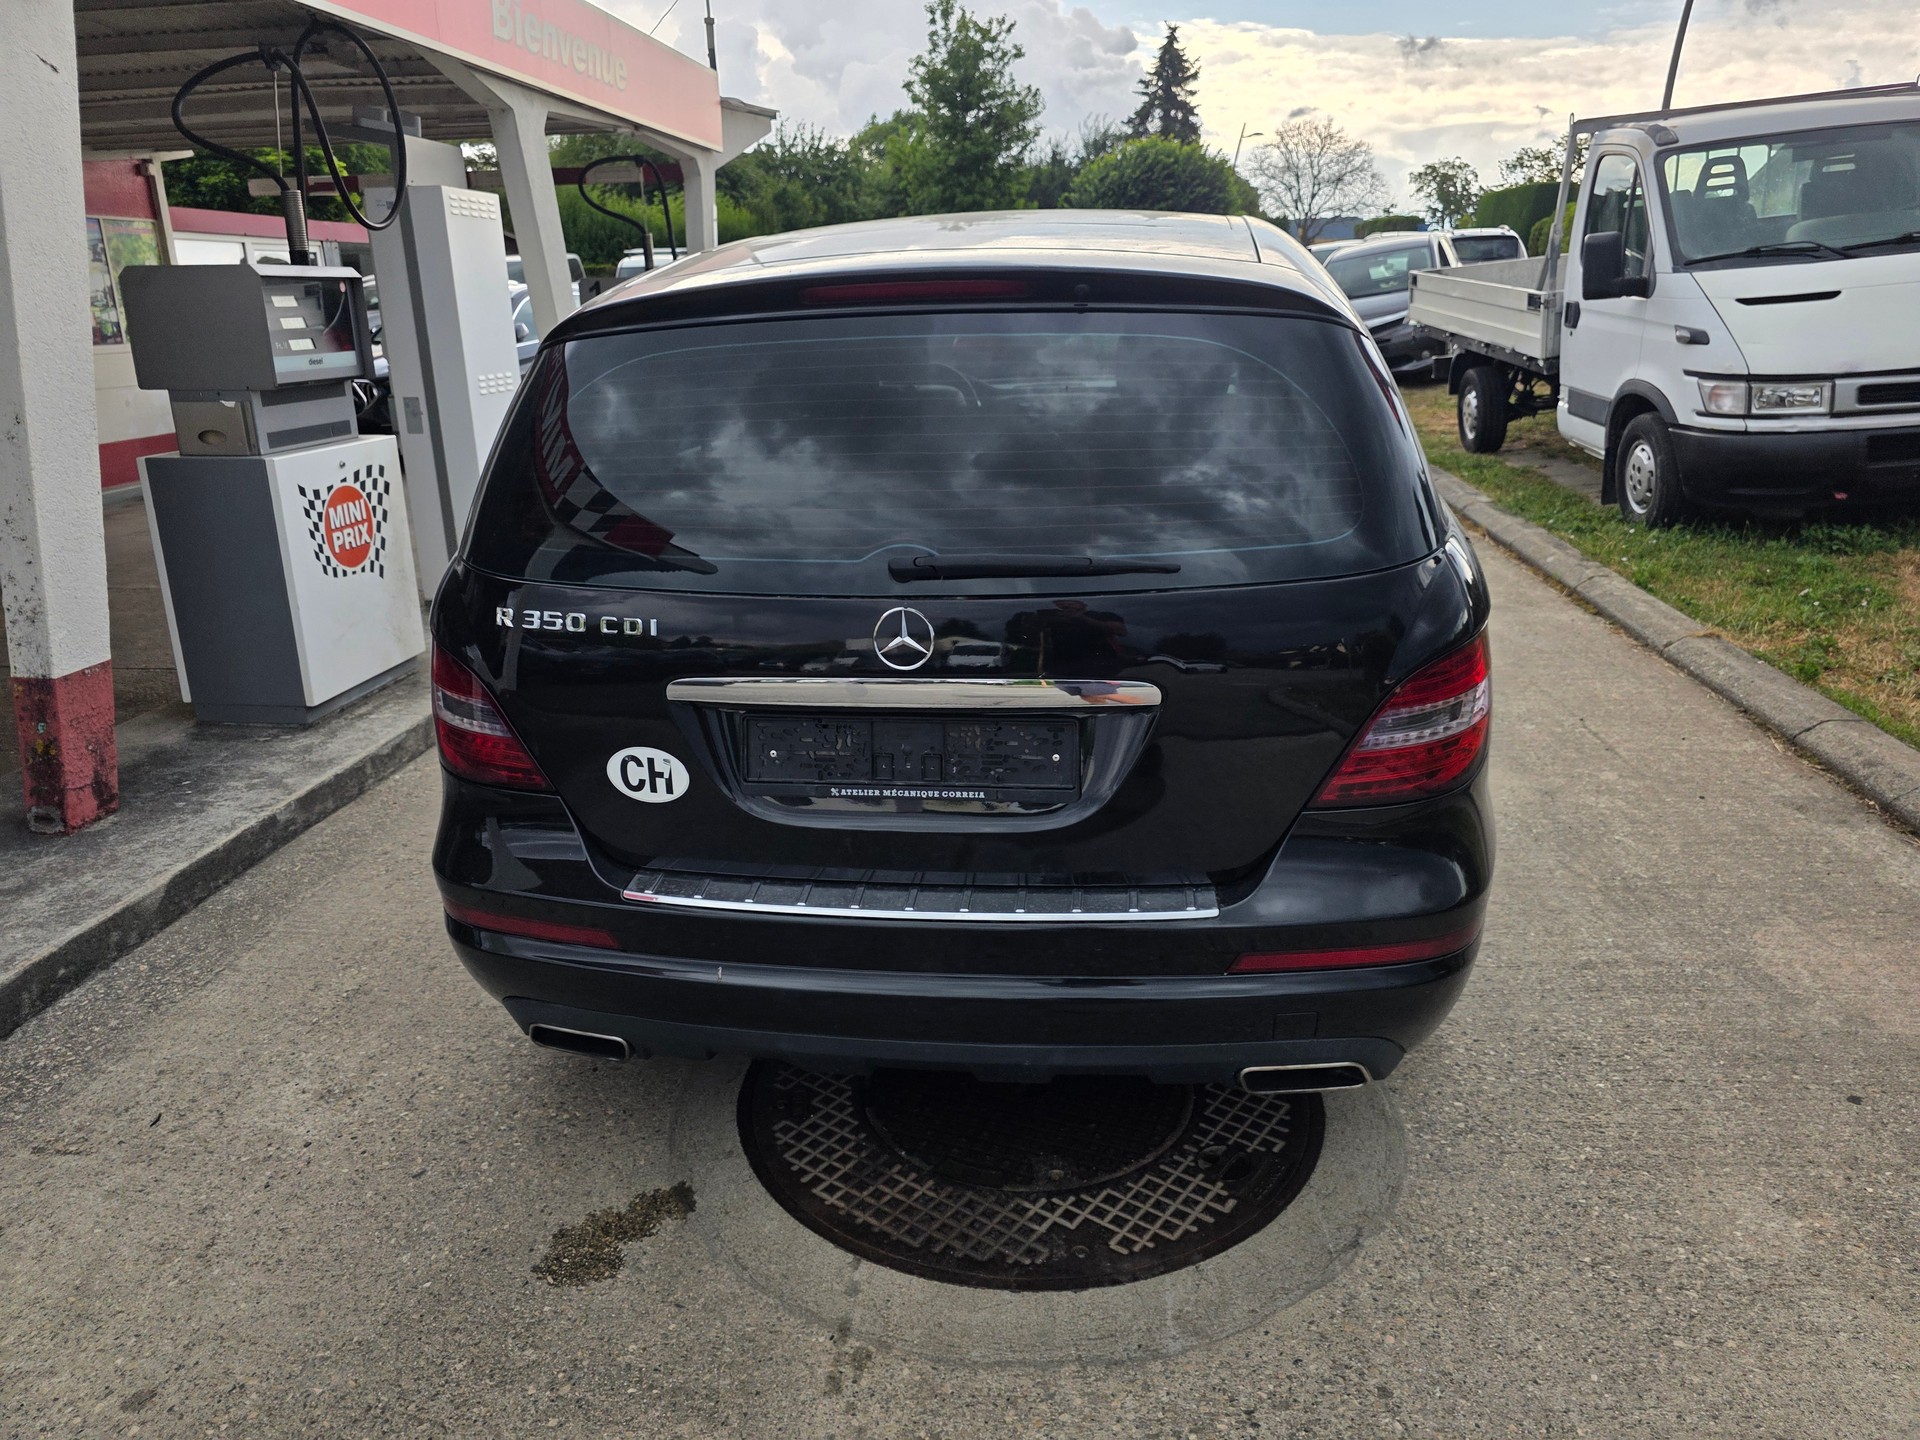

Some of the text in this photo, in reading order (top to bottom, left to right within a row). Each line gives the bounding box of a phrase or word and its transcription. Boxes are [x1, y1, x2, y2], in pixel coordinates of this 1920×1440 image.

[492, 0, 627, 91] Bienvenue
[328, 499, 367, 529] MINI
[332, 522, 371, 553] PRIX
[496, 606, 658, 637] R 350 CDI
[620, 755, 674, 795] CH
[840, 788, 984, 799] ATELIER MÉCANIQUE CORREIA
